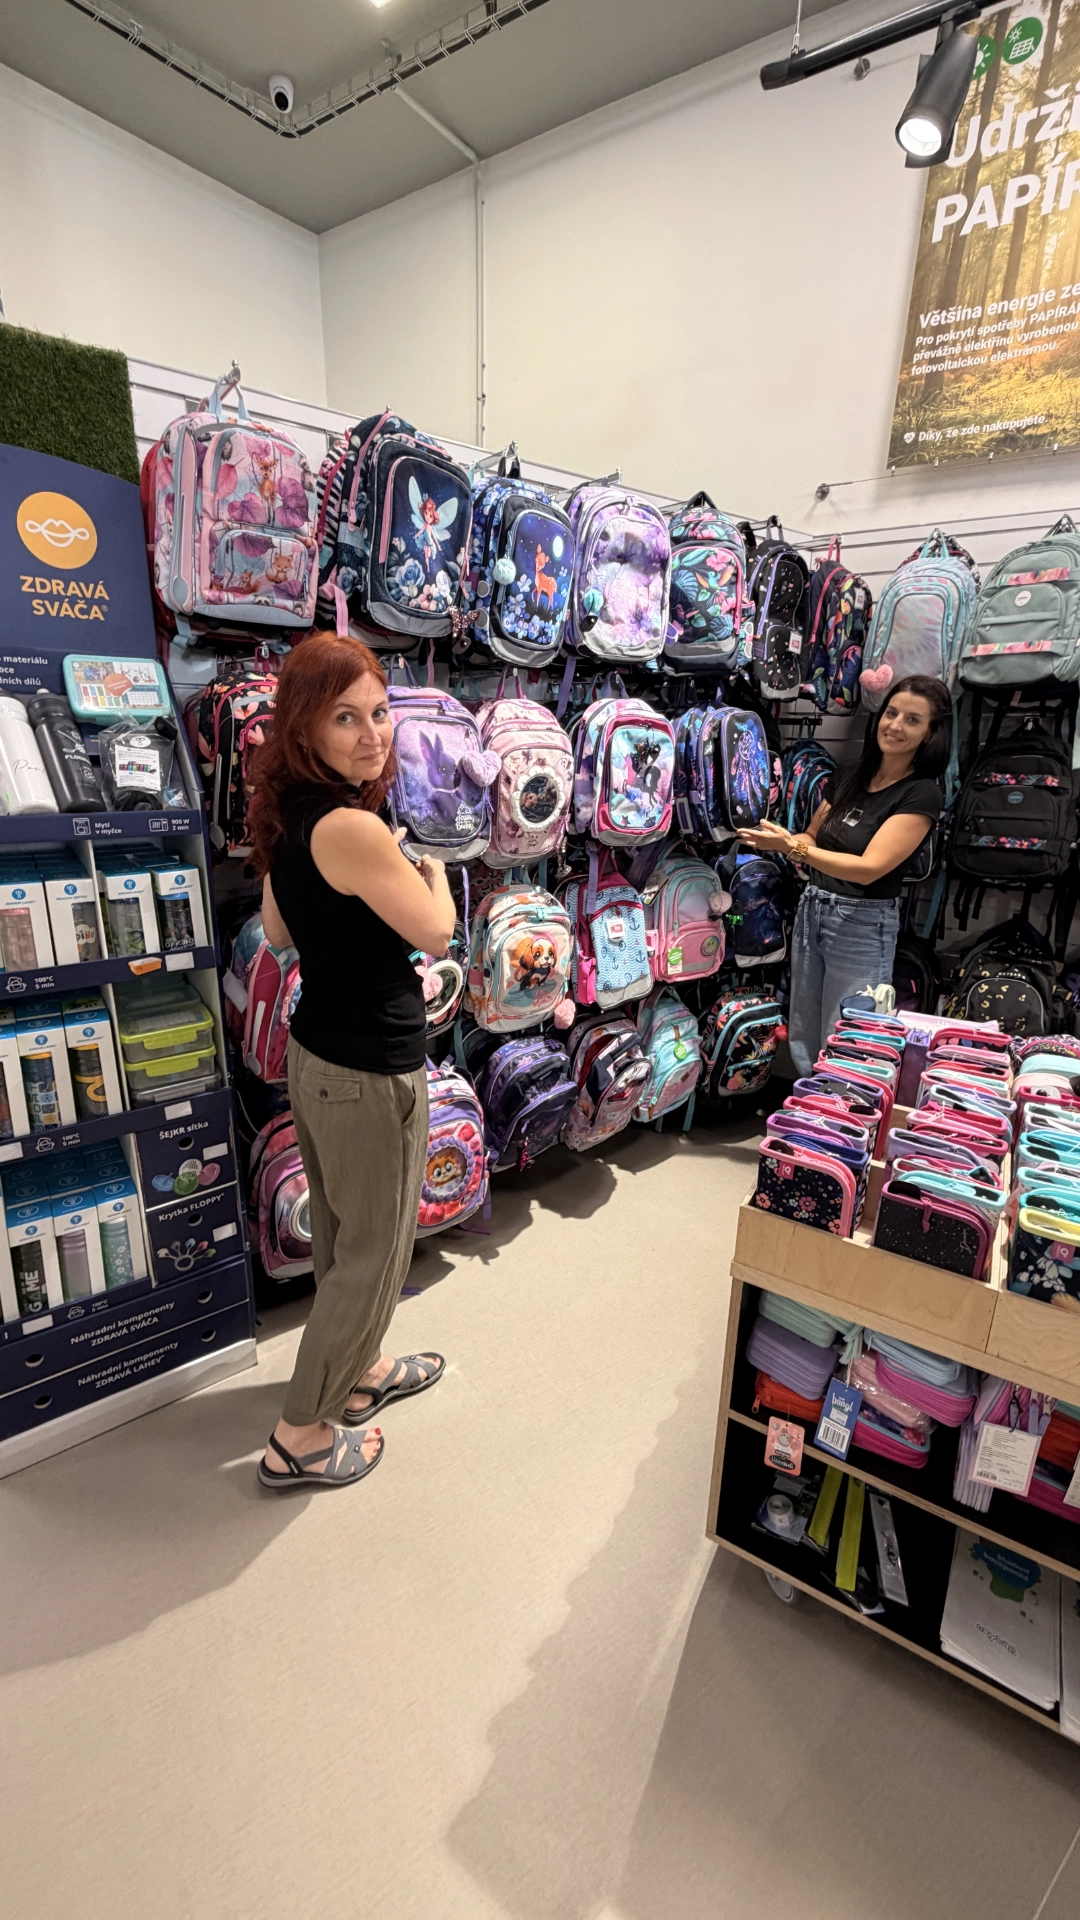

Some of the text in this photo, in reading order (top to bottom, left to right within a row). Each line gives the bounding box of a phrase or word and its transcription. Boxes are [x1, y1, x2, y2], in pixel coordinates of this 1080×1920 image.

[919, 305, 982, 329] Většina
[987, 287, 1056, 316] energie
[912, 321, 1079, 364] převážně elektřinu vyrobenou
[915, 335, 934, 347] Pro
[936, 326, 975, 346] pokrytí
[977, 317, 1027, 339] spotřeby
[911, 342, 1059, 376] fotovoltaickou elektrárnou.
[918, 414, 1049, 443] Díky, že zde nakupujete.
[20, 575, 110, 600] ZDRAVÁ
[3, 656, 48, 665] materiálu
[24, 677, 42, 686] dílů
[94, 821, 110, 830] Mytí
[159, 1120, 209, 1140] ŠEJKR sítka
[158, 1207, 188, 1222] Krytka
[25, 1270, 43, 1313] GAME
[70, 1301, 175, 1345] Náhradní komponenty
[91, 1316, 159, 1347] ZDRAVÁ SVÁČA
[77, 1341, 179, 1386] Náhradní komponenty
[95, 1368, 132, 1389] ZDRAVÁ
